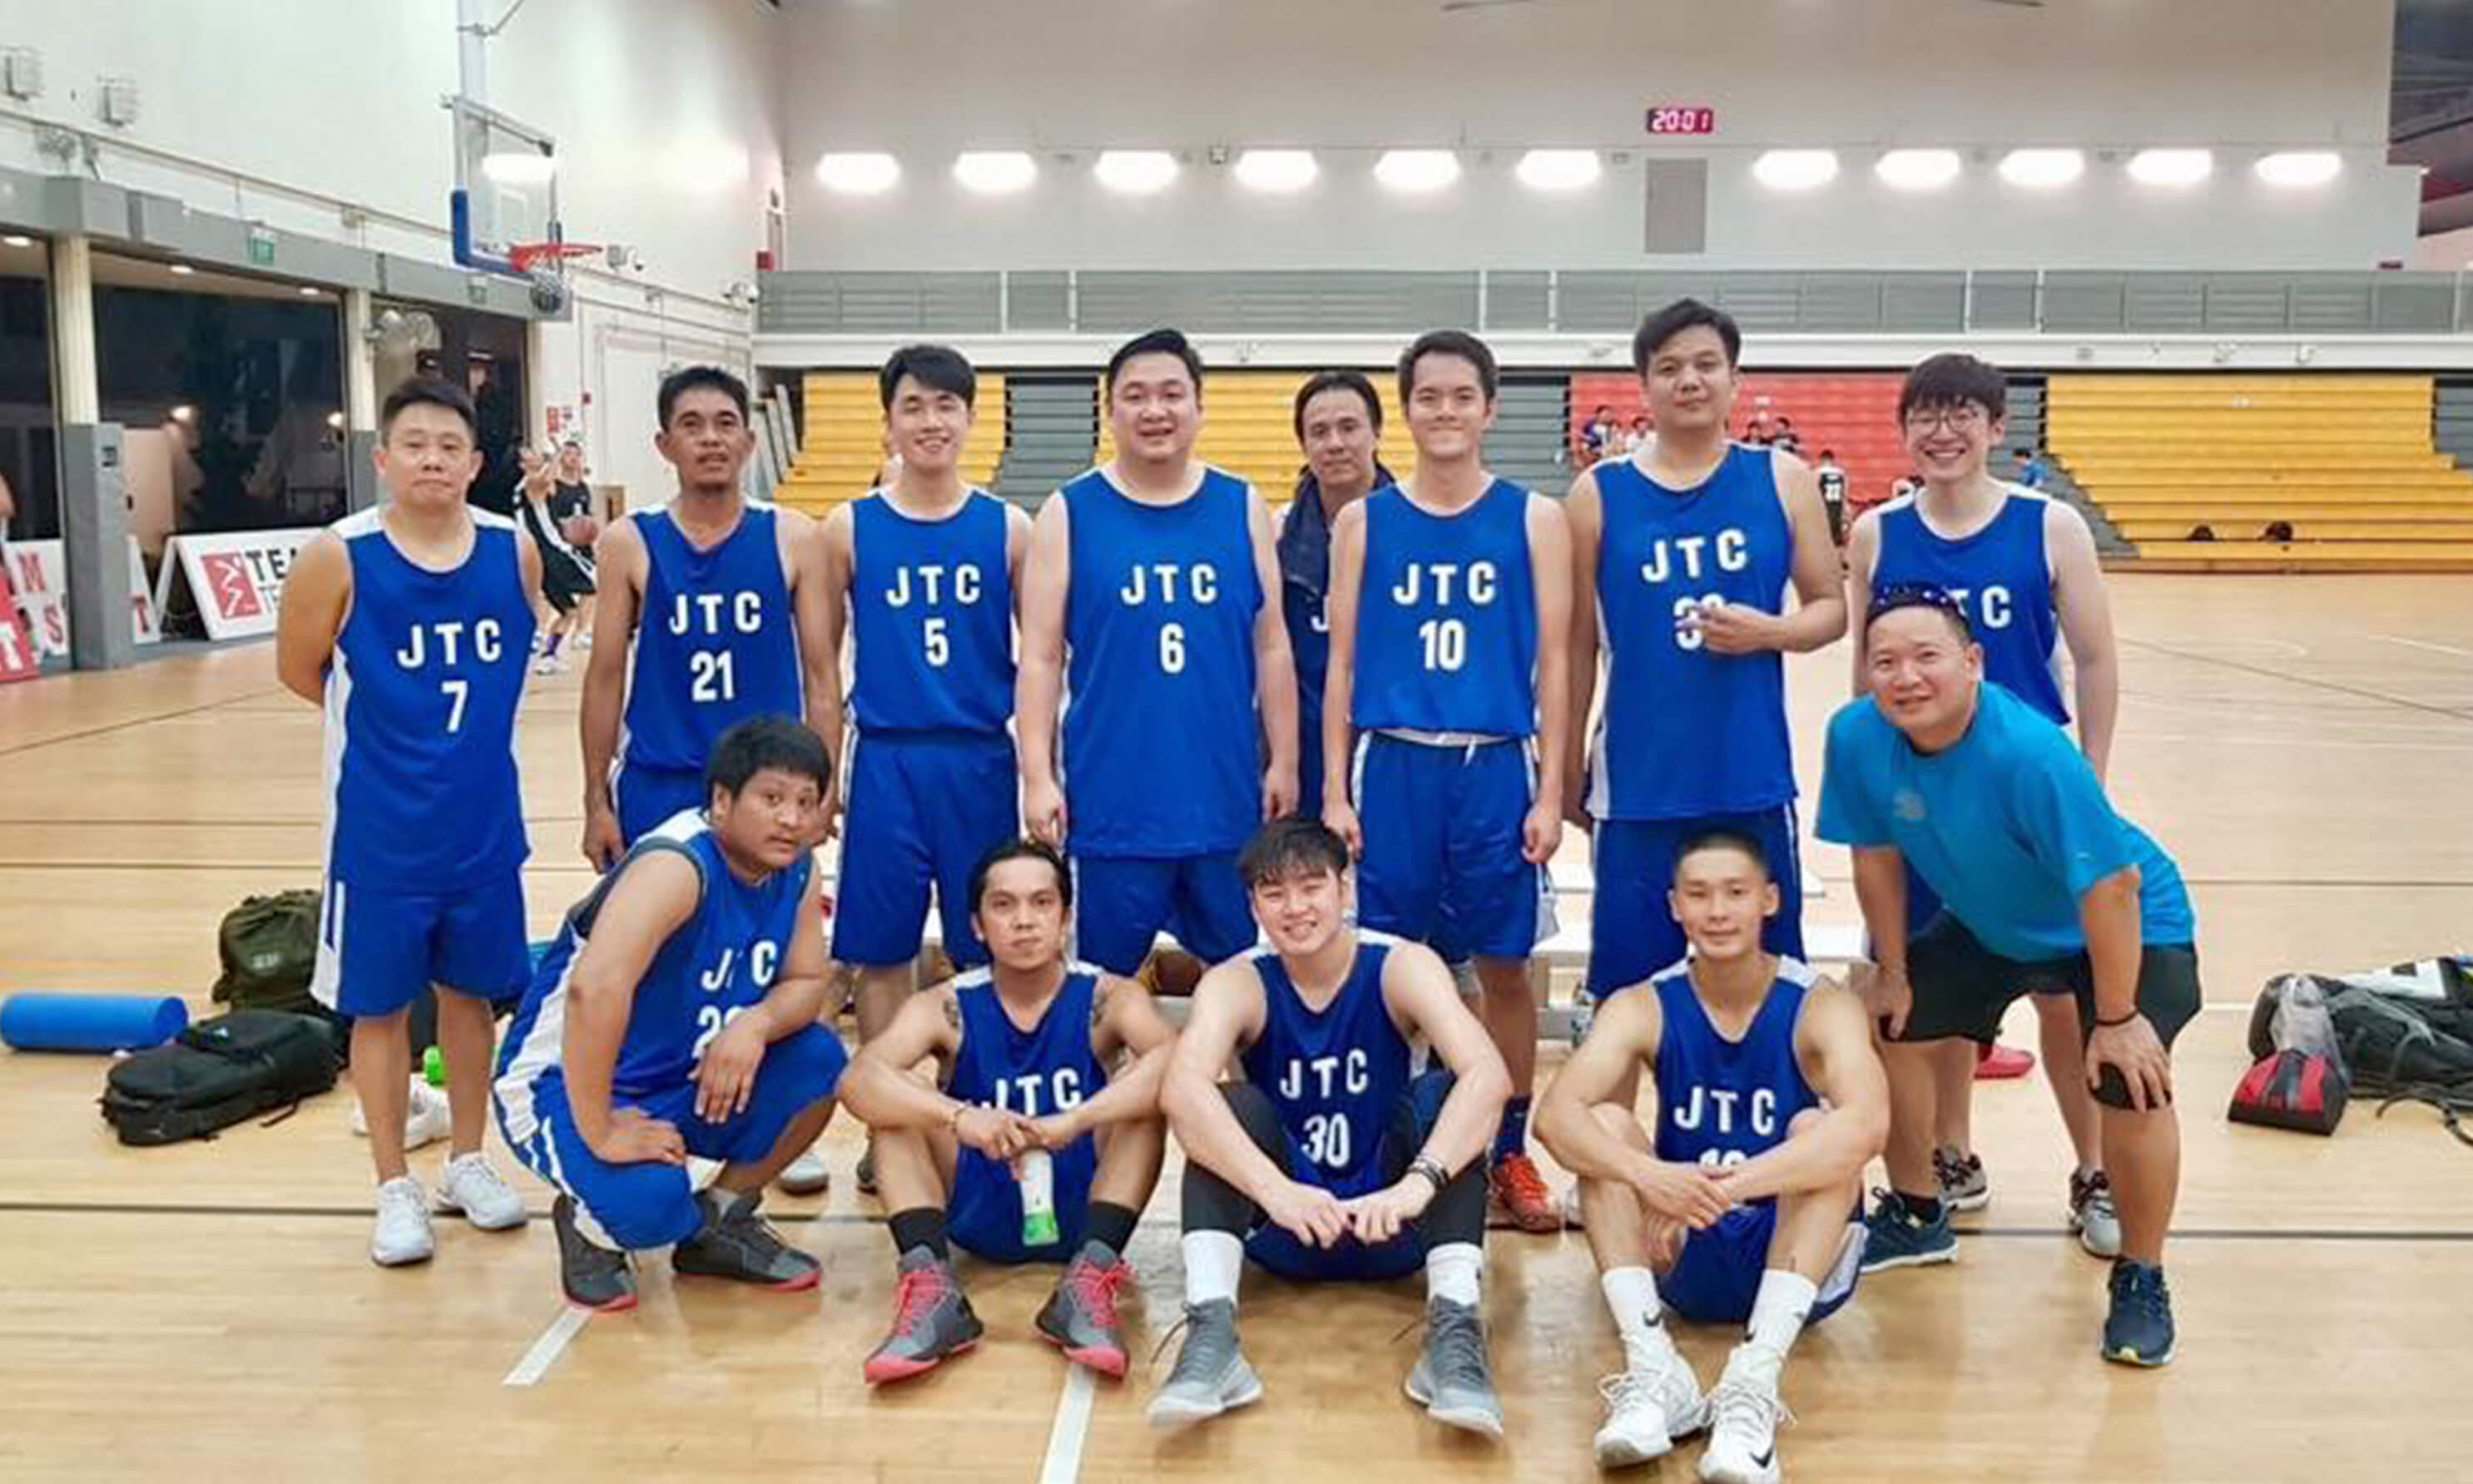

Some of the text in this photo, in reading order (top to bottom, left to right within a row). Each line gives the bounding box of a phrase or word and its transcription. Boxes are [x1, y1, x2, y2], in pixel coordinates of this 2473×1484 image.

[245, 549, 296, 583] TE
[1641, 528, 1747, 582] JTC
[885, 565, 980, 606] JTC
[1120, 564, 1217, 605] JTC
[1392, 561, 1495, 605] JTC
[668, 591, 761, 635] JTC
[397, 619, 501, 668] JTC
[924, 618, 949, 665] 5
[1160, 623, 1185, 673] 6
[1420, 620, 1464, 670] 10
[690, 650, 734, 701] 21
[441, 680, 468, 732] 7
[1281, 1048, 1368, 1100] JTC
[1674, 1086, 1776, 1135] JTC
[1301, 1111, 1350, 1167] 30
